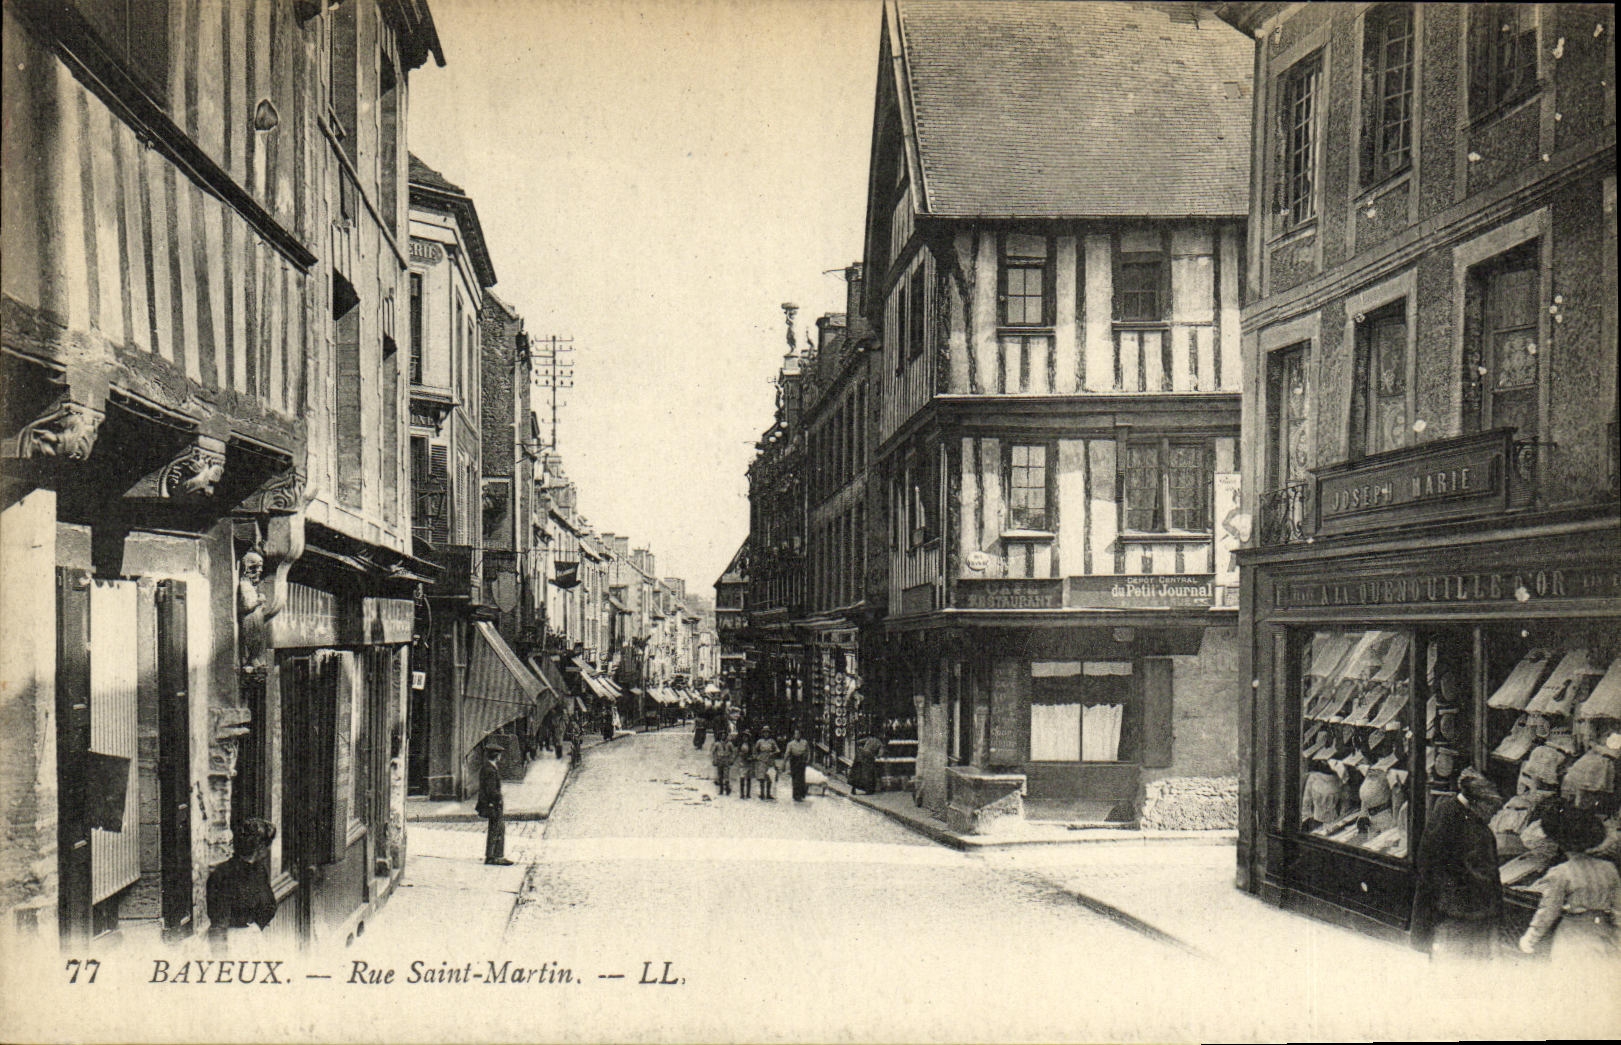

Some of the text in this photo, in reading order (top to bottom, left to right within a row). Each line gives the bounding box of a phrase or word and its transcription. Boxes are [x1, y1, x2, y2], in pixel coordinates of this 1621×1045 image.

[1331, 468, 1470, 510] JOSEPH MARIE
[1111, 584, 1125, 597] du
[1126, 584, 1155, 597] Petit
[1159, 582, 1213, 597] Journal
[1321, 584, 1330, 605] A
